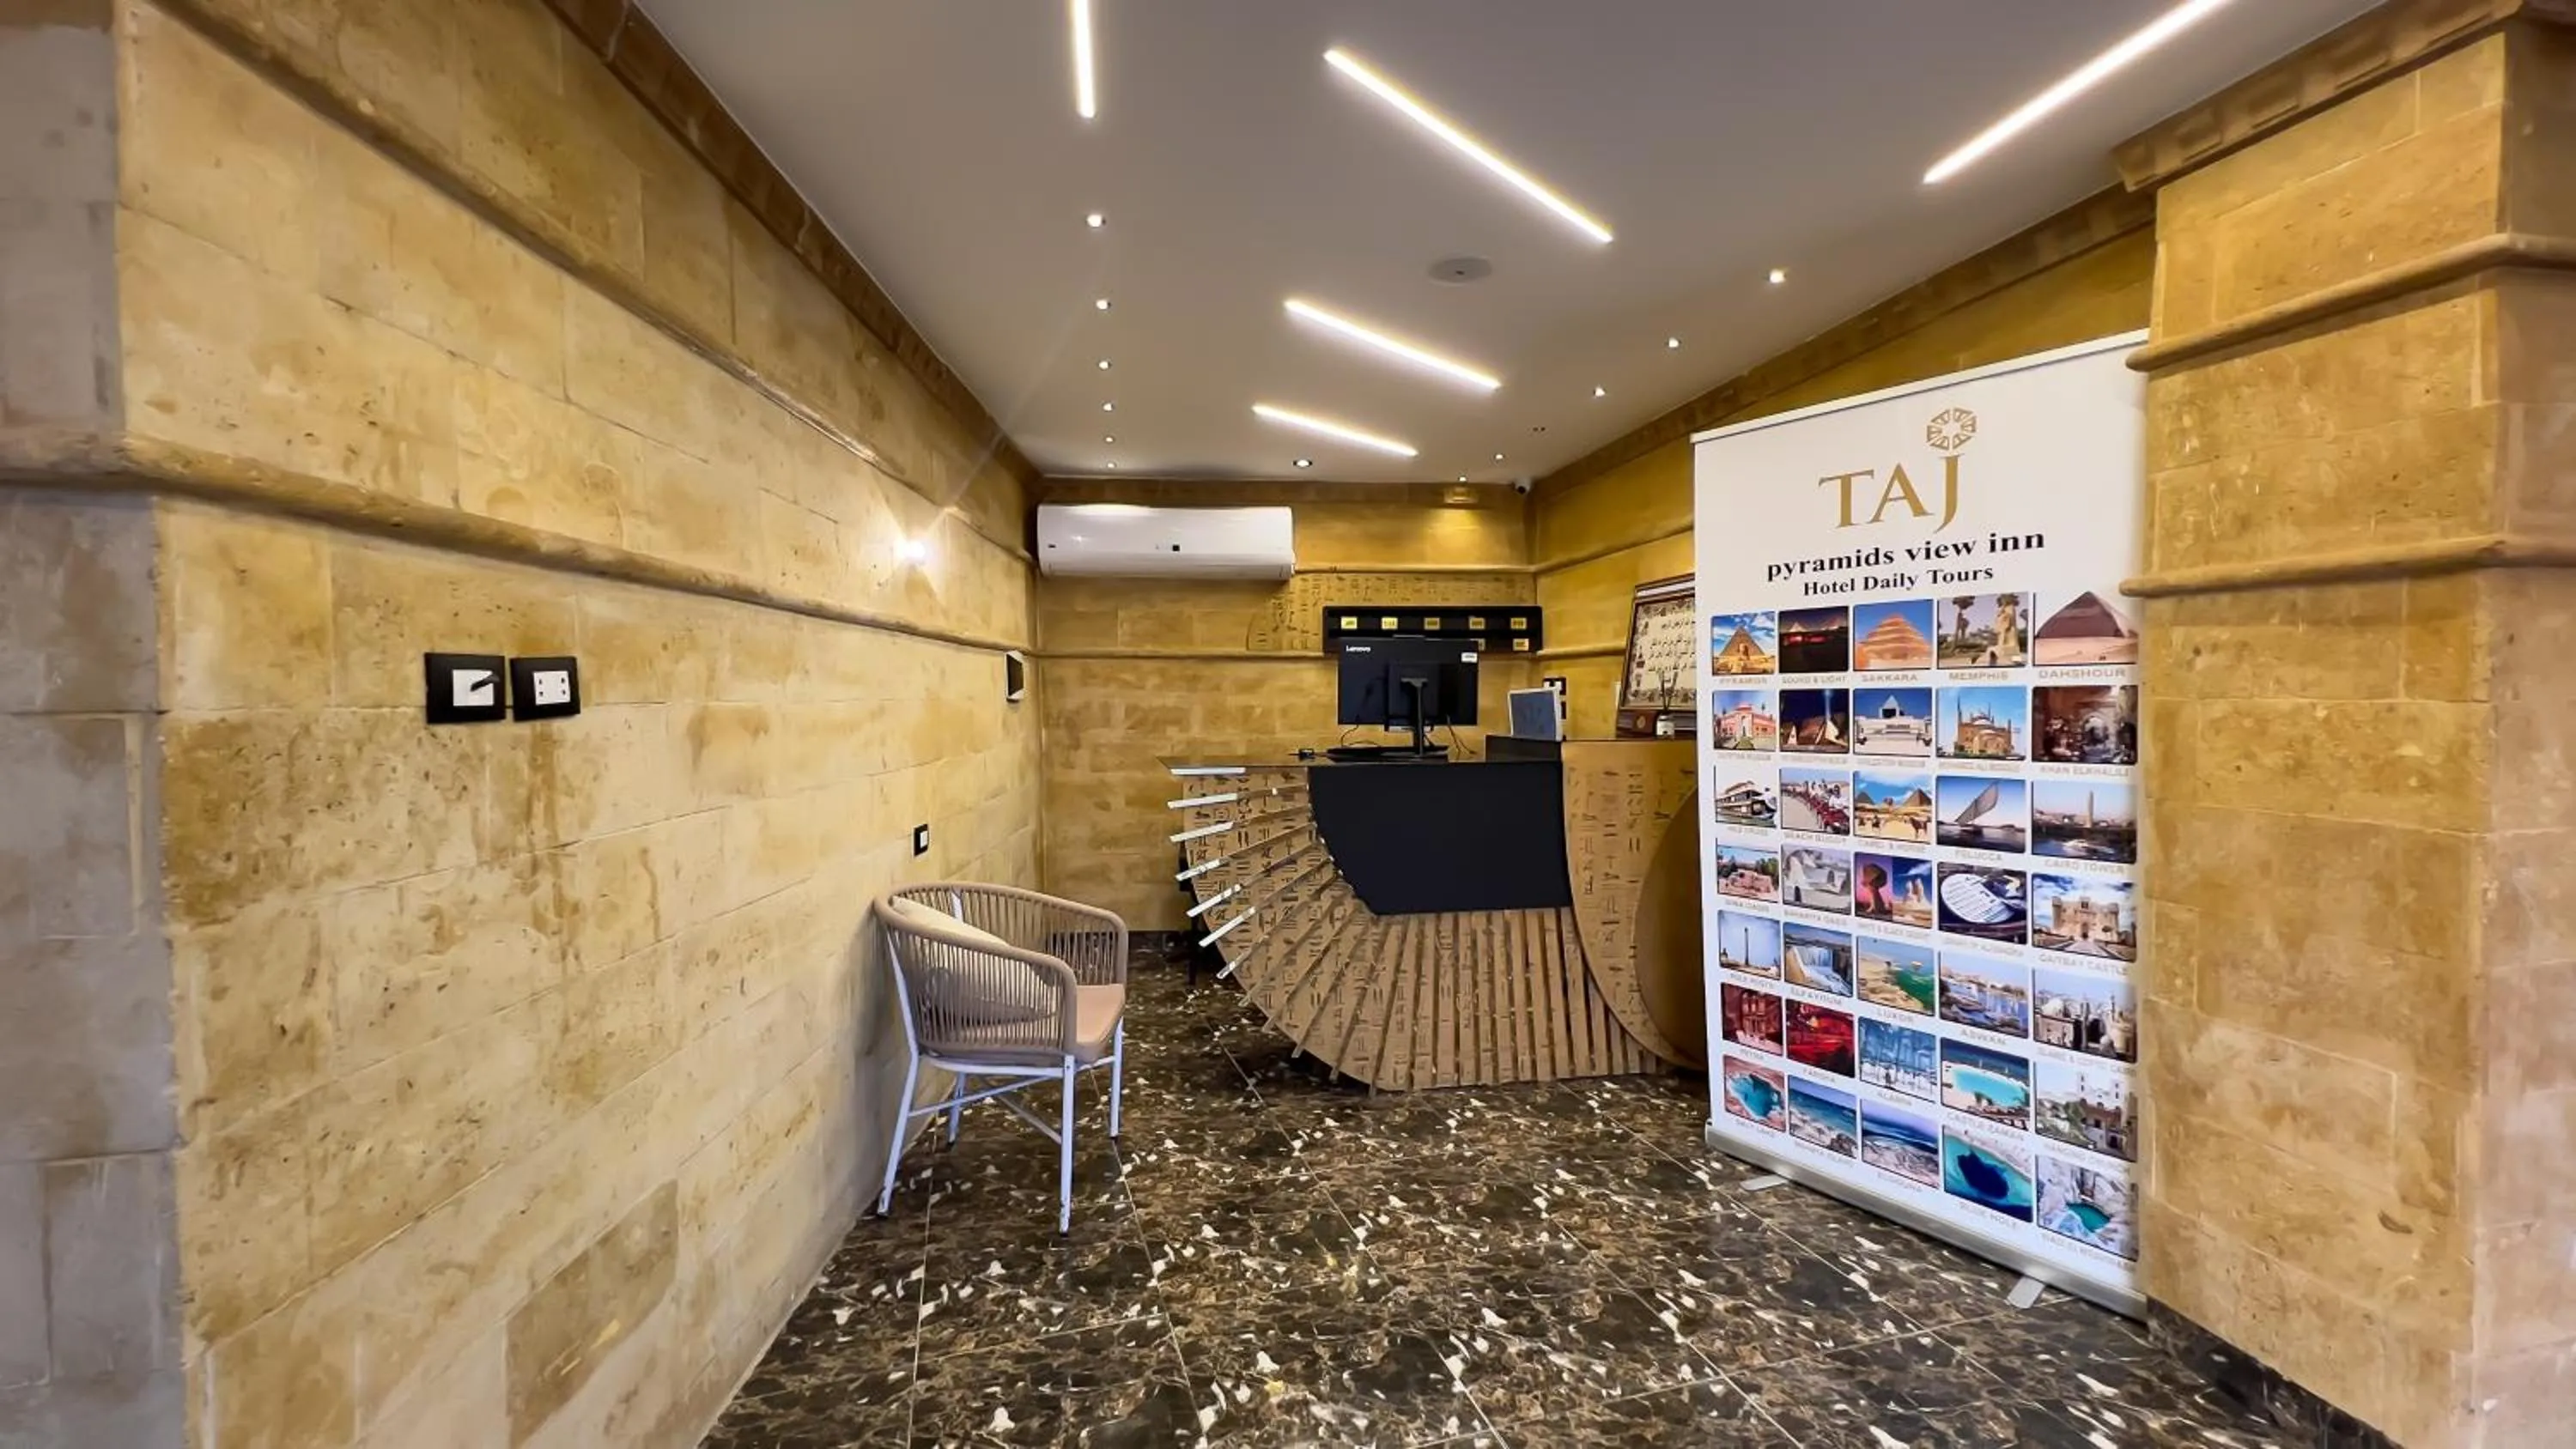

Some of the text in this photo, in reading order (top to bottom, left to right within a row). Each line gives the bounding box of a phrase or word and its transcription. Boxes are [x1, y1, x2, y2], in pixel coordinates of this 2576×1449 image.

[1818, 452, 1965, 534] TAJ
[1767, 530, 2045, 582] pyramids view inn
[1803, 566, 1994, 597] Hotel Daily Tours
[1820, 675, 1848, 683] LIGHT
[1862, 674, 1918, 682] SAKKARA
[1948, 671, 2009, 681] MEMPHIS
[2038, 669, 2126, 678] DAHSHOUR
[1954, 849, 2002, 861] FELUCCA
[2044, 859, 2080, 870] CAIRO
